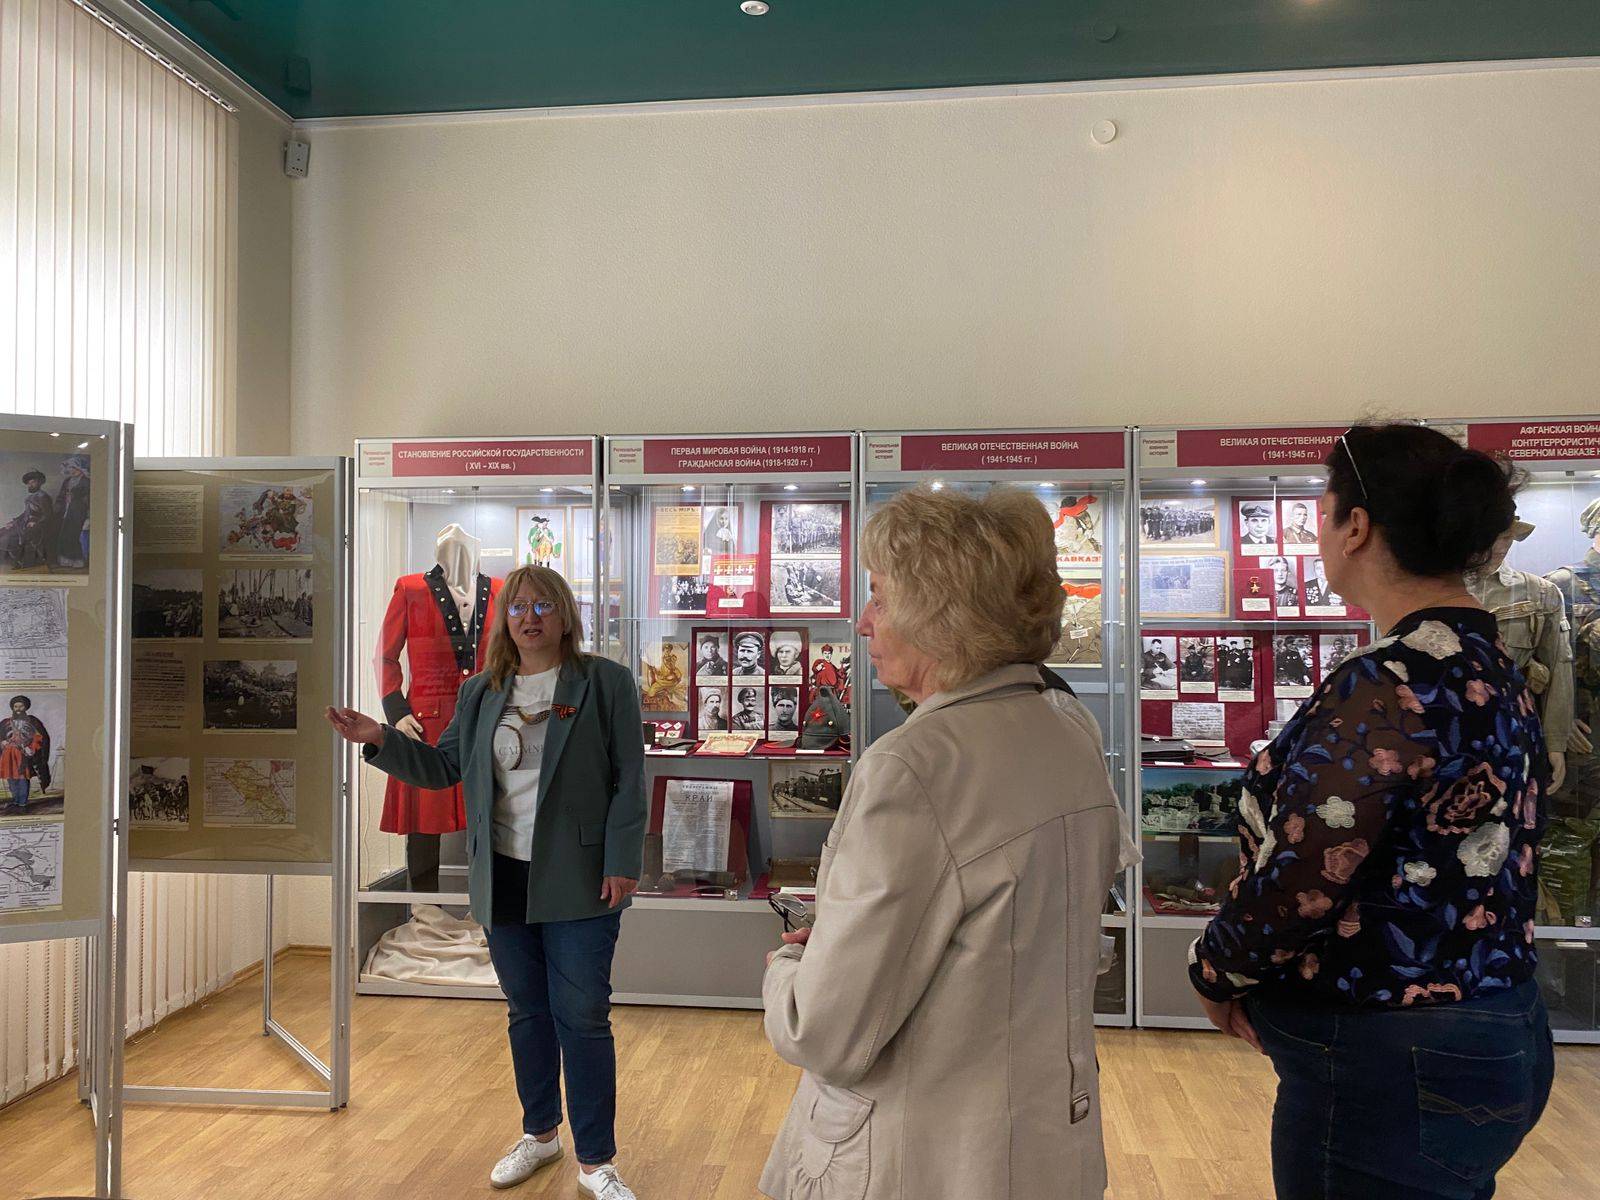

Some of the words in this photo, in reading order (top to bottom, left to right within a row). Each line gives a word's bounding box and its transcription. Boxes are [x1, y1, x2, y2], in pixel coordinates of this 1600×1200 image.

[1520, 426, 1572, 435] АФГАНСКАЯ
[1574, 424, 1600, 434] ВОЙН
[941, 442, 978, 451] ВЕЛИКАЯ
[979, 441, 1049, 450] ОТЕЧЕСТВЕННАЯ
[1050, 440, 1079, 450] ВОЙНА
[1220, 437, 1259, 447] ВЕЛИКАЯ
[1261, 436, 1332, 446] ОТЕЧЕСТВЕННАЯ
[398, 450, 451, 459] СТАНОВЛЕНИЕ
[452, 447, 501, 458] РОССИЙСКОЙ
[502, 448, 584, 458] ГОСУДАРСТВЕННОСТИ
[671, 447, 701, 456] ПЕРВАЯ
[702, 446, 739, 455] МИРОВАЯ
[740, 445, 767, 455] ВОЙНА
[1508, 448, 1556, 458] СЕВЕРНОМ
[1557, 447, 1595, 457] КАВКАЗЕ
[678, 459, 734, 468] ГРАЖДАНСКАЯ
[735, 458, 761, 468] ВОЙНА
